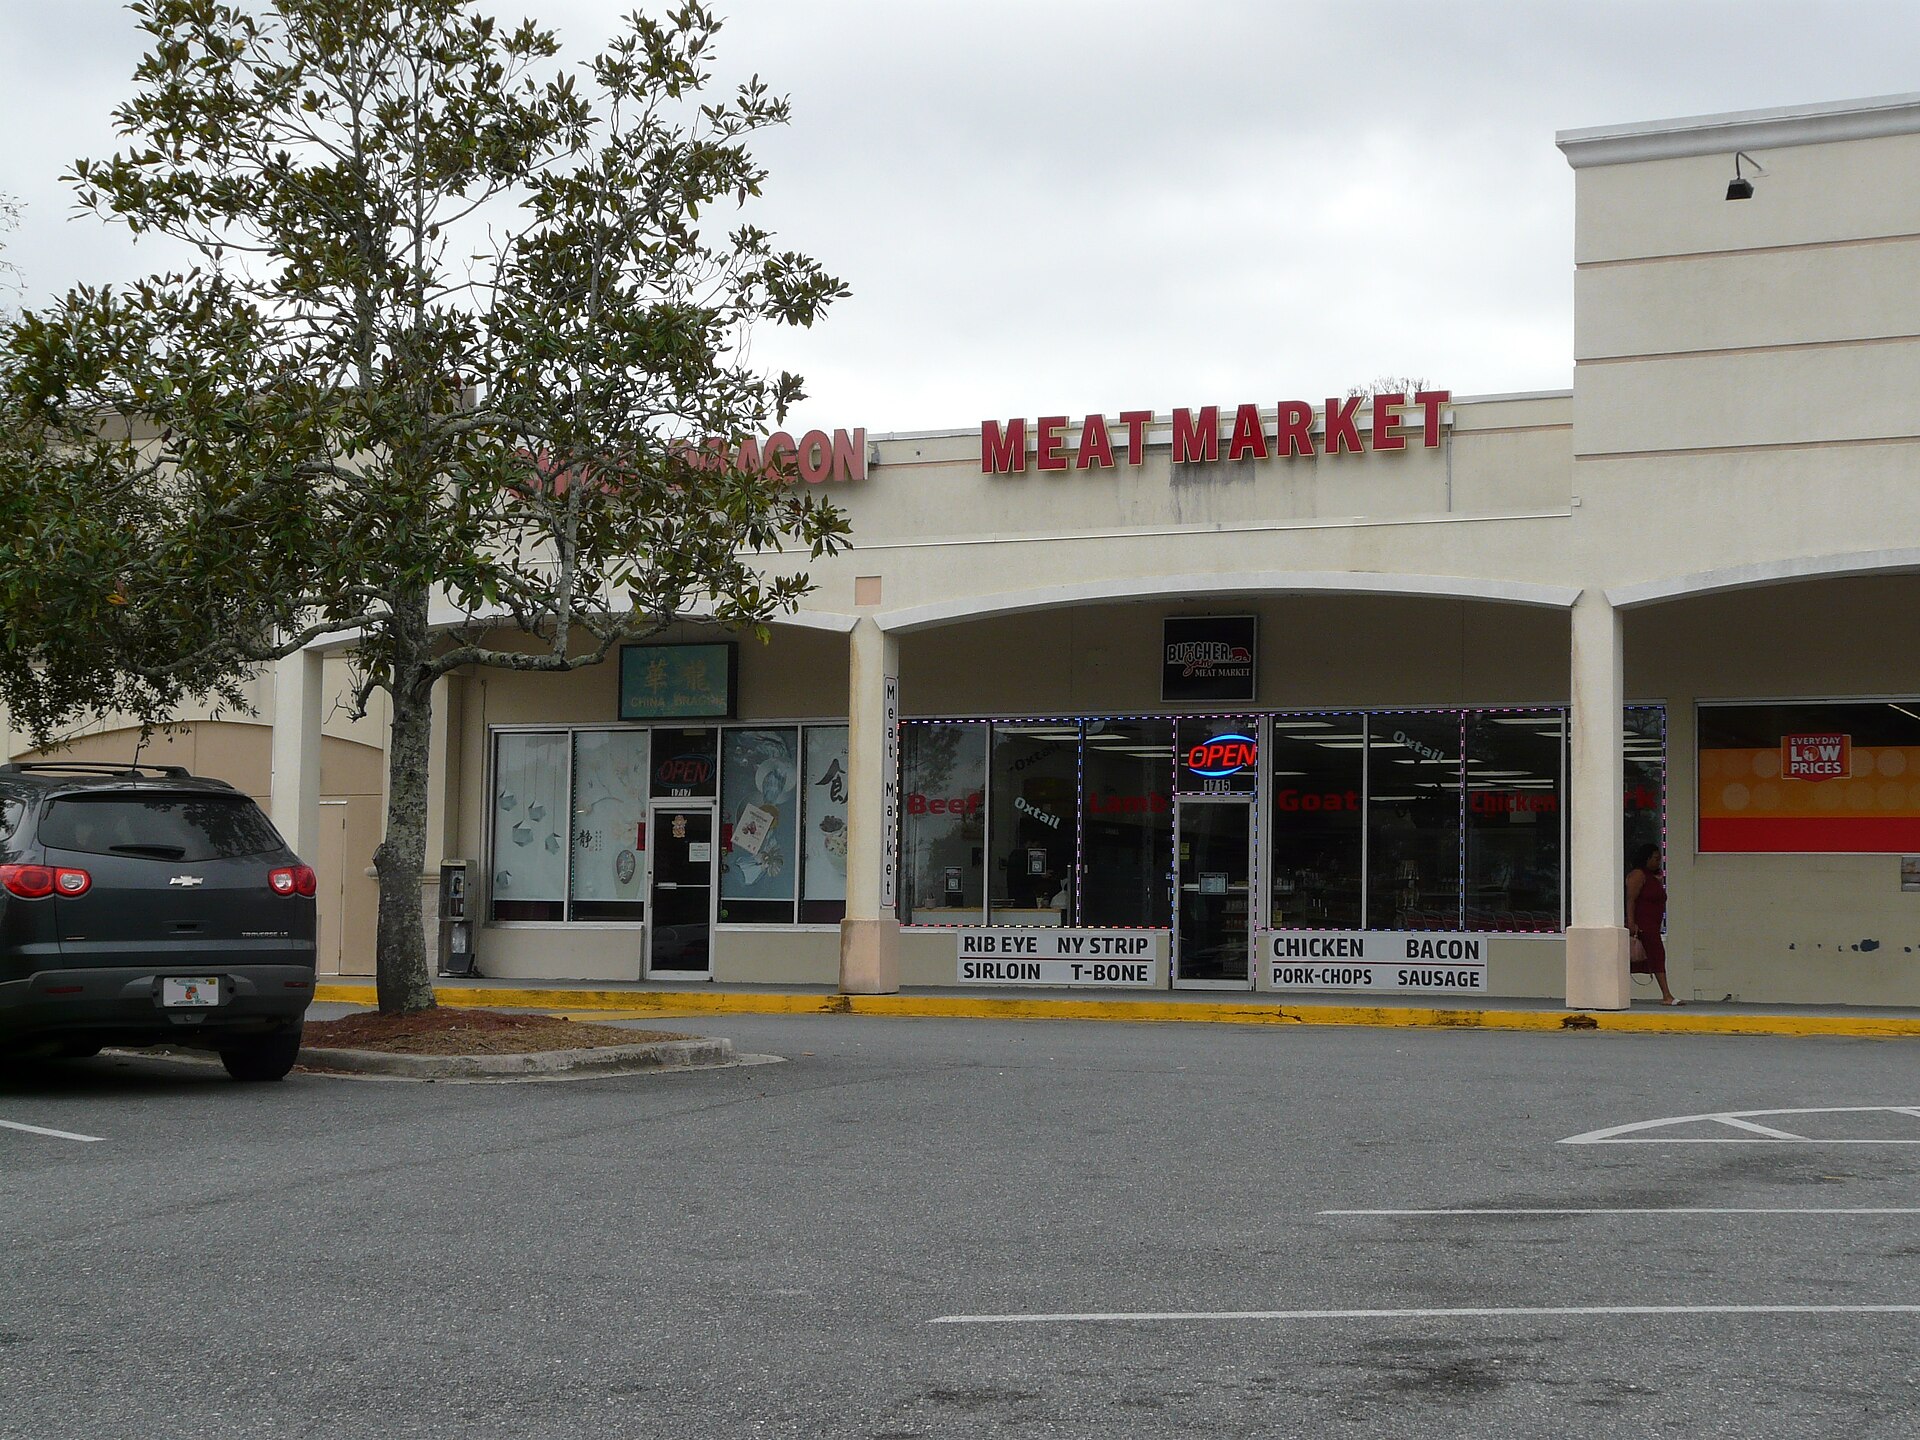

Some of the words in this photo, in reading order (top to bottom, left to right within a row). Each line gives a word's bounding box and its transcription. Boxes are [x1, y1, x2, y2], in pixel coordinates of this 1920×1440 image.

[981, 410, 1155, 475] MEAT
[1172, 390, 1452, 463] MARKET
[1167, 642, 1230, 664] BUTCHER
[1194, 668, 1217, 677] MEAT
[1218, 668, 1250, 677] MARKET
[886, 684, 895, 759] Meat
[1188, 743, 1257, 768] OPEN
[1393, 730, 1445, 762] Oxtail
[659, 760, 709, 784] OPEN
[1791, 762, 1842, 774] PRICES
[1204, 780, 1230, 791] 1715
[906, 792, 984, 815] Beef
[1090, 790, 1168, 814] Lamb
[1278, 788, 1361, 812] Goat
[1471, 790, 1557, 814] Chicken
[1014, 796, 1061, 830] Oxtail
[885, 782, 894, 896] Market
[963, 936, 996, 952] RIB
[1001, 936, 1038, 953] EYE
[1057, 937, 1084, 954] NY
[1090, 937, 1148, 955] STRIP
[1273, 938, 1364, 958] CHICKEN
[1406, 939, 1479, 960] BACON
[963, 962, 1041, 980] SIRLOIN
[1071, 963, 1148, 982] T-BONE
[1273, 968, 1372, 985] PORK-CHOPS
[1397, 969, 1480, 988] SAUSAGE
